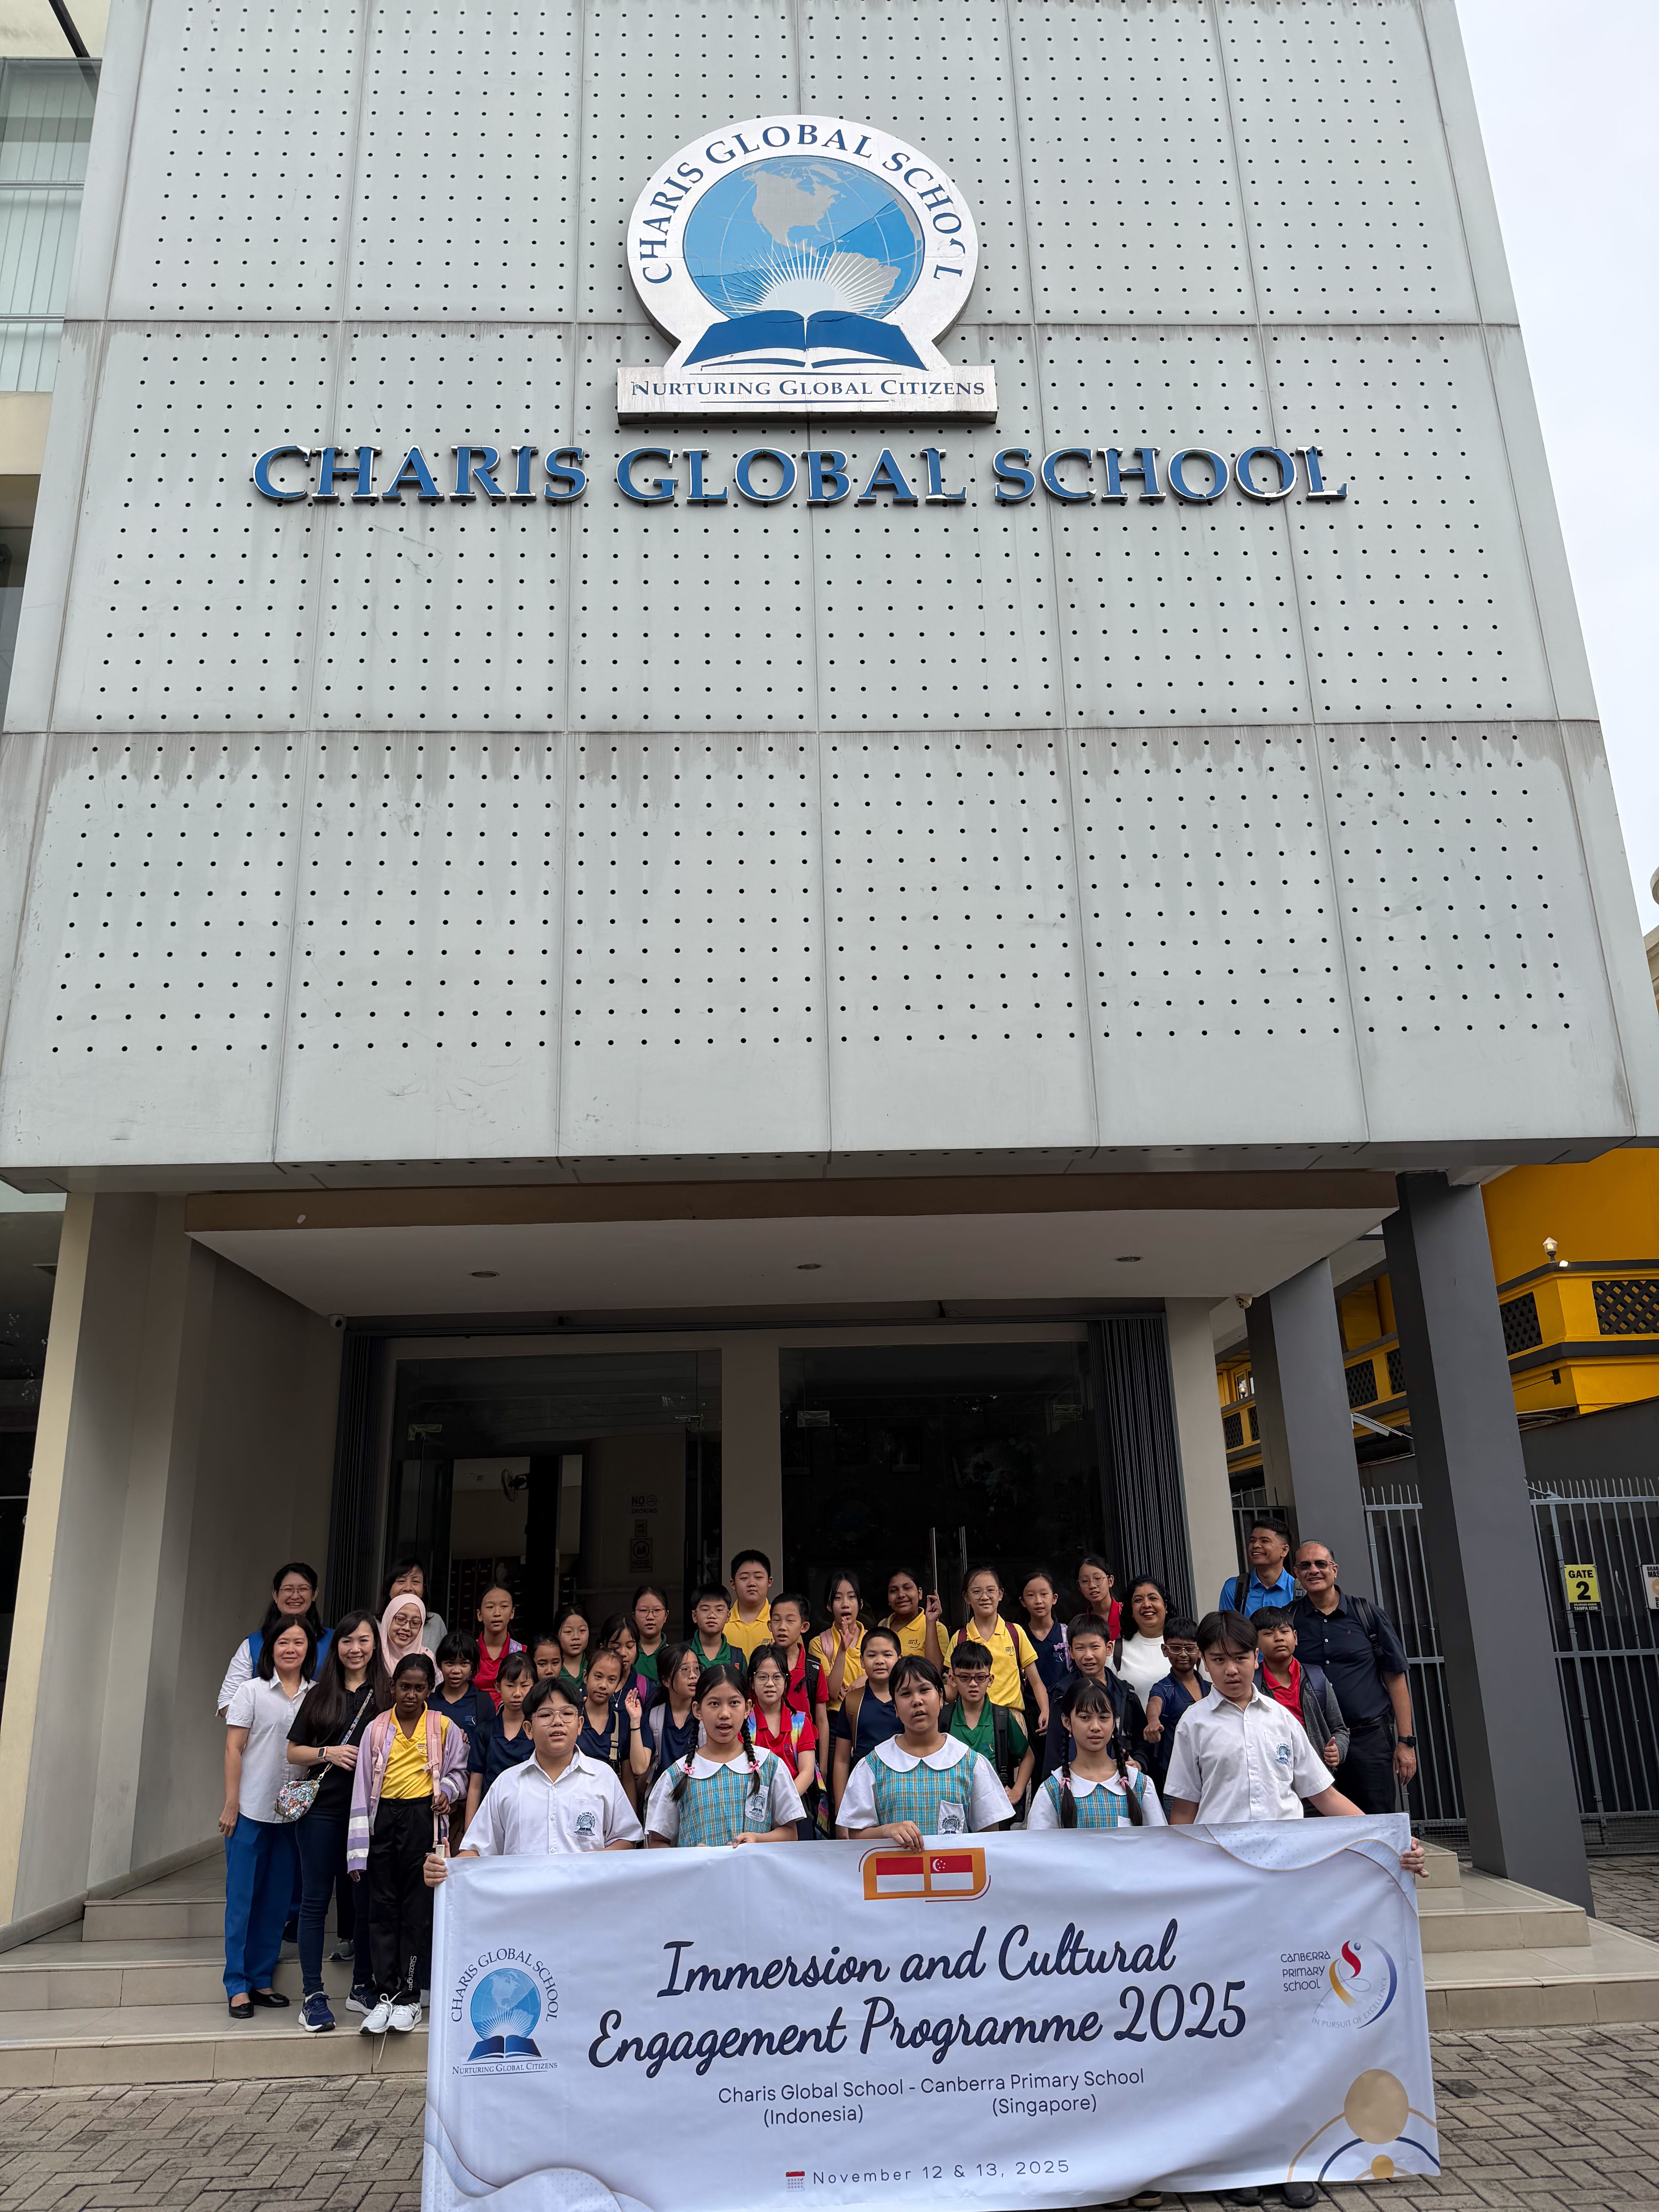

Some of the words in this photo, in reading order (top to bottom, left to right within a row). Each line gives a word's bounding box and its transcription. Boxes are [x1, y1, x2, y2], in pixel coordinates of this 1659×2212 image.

[639, 162, 704, 284] CHARIS
[706, 124, 873, 164] GLOBAL
[631, 381, 771, 396] NURTURING
[779, 380, 873, 395] GLOBAL
[881, 380, 985, 395] CITIZENS
[253, 445, 587, 502] CHARIS
[616, 446, 967, 503] GLOBAL
[992, 446, 1348, 503] SCHOOL
[631, 1496, 645, 1505] NO
[1568, 1570, 1594, 1578] GATE
[1576, 1581, 1591, 1600] 2
[407, 1955, 417, 1991] Slazenger
[657, 1941, 890, 1998] Immersion
[900, 1926, 987, 1983] and
[998, 1918, 1178, 1981] Cultural
[451, 1964, 478, 2022] CHARIS
[478, 1948, 532, 1967] GLOBAL
[532, 1961, 558, 2022] SCHOOL
[1311, 2017, 1321, 2027] IN
[1322, 2019, 1351, 2028] PURSUIT
[1352, 2015, 1364, 2024] OF
[1362, 1977, 1387, 2019] EXCELLENCE
[588, 2006, 848, 2078] Engagement
[860, 1996, 1103, 2064] Programme
[1113, 1980, 1246, 2042] 2025
[452, 2066, 494, 2075] NURTURING
[496, 2064, 524, 2072] GLOBAL
[719, 2086, 776, 2103] Charis
[781, 2082, 838, 2100] Global
[843, 2079, 903, 2097] School
[921, 2076, 1005, 2093] Canberra
[1011, 2073, 1079, 2091] Primary
[1084, 2068, 1144, 2086] School
[764, 2104, 863, 2128] (Indonesia)
[993, 2094, 1097, 2117] (Singapore)
[813, 2169, 911, 2185] November
[922, 2166, 942, 2179] 12
[954, 2165, 965, 2178] &
[976, 2163, 1004, 2178] 13,
[1016, 2160, 1068, 2175] 2025
